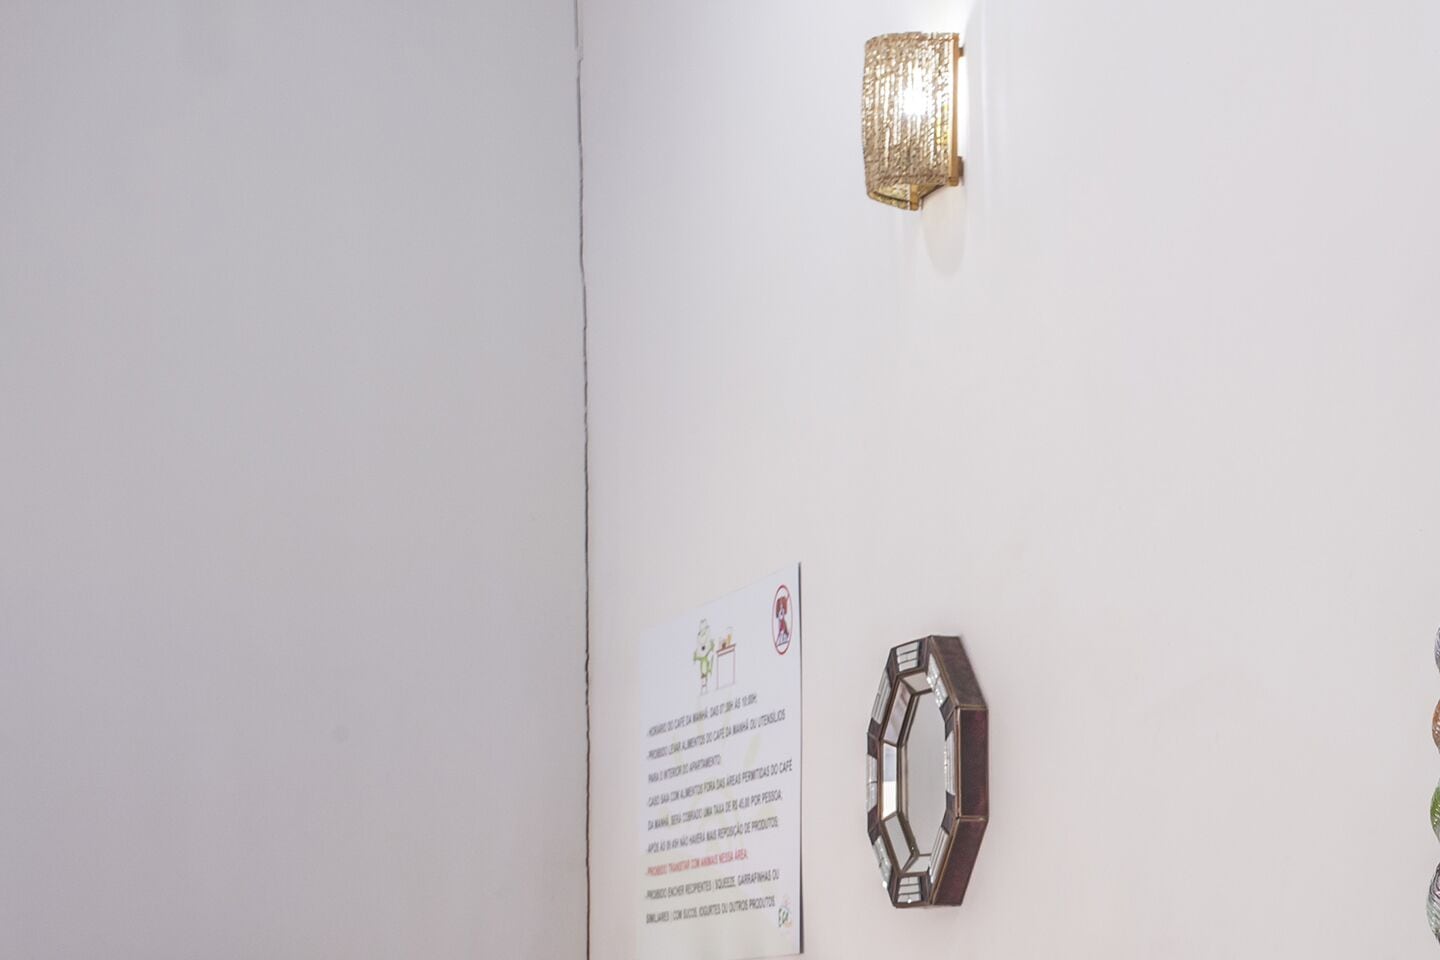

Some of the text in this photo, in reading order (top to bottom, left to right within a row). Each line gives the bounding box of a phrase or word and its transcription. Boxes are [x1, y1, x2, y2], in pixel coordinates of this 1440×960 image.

[667, 720, 673, 731] DO
[674, 714, 685, 729] CAFÉ
[685, 714, 691, 725] DA
[709, 704, 718, 717] DAS
[668, 741, 681, 754] LEVAR
[681, 733, 705, 750] ALIMENTOS
[705, 731, 712, 743] DO
[712, 725, 724, 741] CAFÉ
[725, 725, 731, 737] DA
[732, 717, 748, 735] MANHÃ
[749, 717, 756, 730] OU
[757, 708, 786, 727] UTENSÍLIOS
[648, 772, 659, 783] PARA
[663, 765, 681, 779] INTERIOR
[682, 763, 688, 774] DO
[669, 790, 679, 802] COM
[679, 783, 702, 799] ALIMENTOS
[703, 780, 715, 792] FORA
[716, 777, 725, 789] DAS
[742, 765, 770, 782] PERMITIDAS
[770, 762, 778, 775] DO
[778, 756, 792, 773] CAFÉ
[647, 820, 653, 830] DA
[702, 805, 712, 818] UMA
[712, 802, 724, 815] TAXA
[724, 801, 731, 812] DE
[731, 798, 737, 811] R$
[750, 793, 760, 806] POR
[679, 834, 688, 847] NÃO
[706, 829, 716, 841] MAIS
[717, 821, 743, 839] REPOSIÇÃO
[744, 822, 750, 833] DE
[690, 858, 699, 869] COM
[667, 884, 684, 897] ENCHER
[684, 880, 711, 894] RECIPIENTES
[737, 869, 771, 886] GARRAFINHAS
[772, 868, 779, 880] OU
[671, 909, 681, 920] COM
[698, 903, 720, 916] IOGURTES
[720, 902, 728, 913] OU
[728, 899, 748, 912] OUTROS
[748, 895, 775, 909] PRODUTOS
